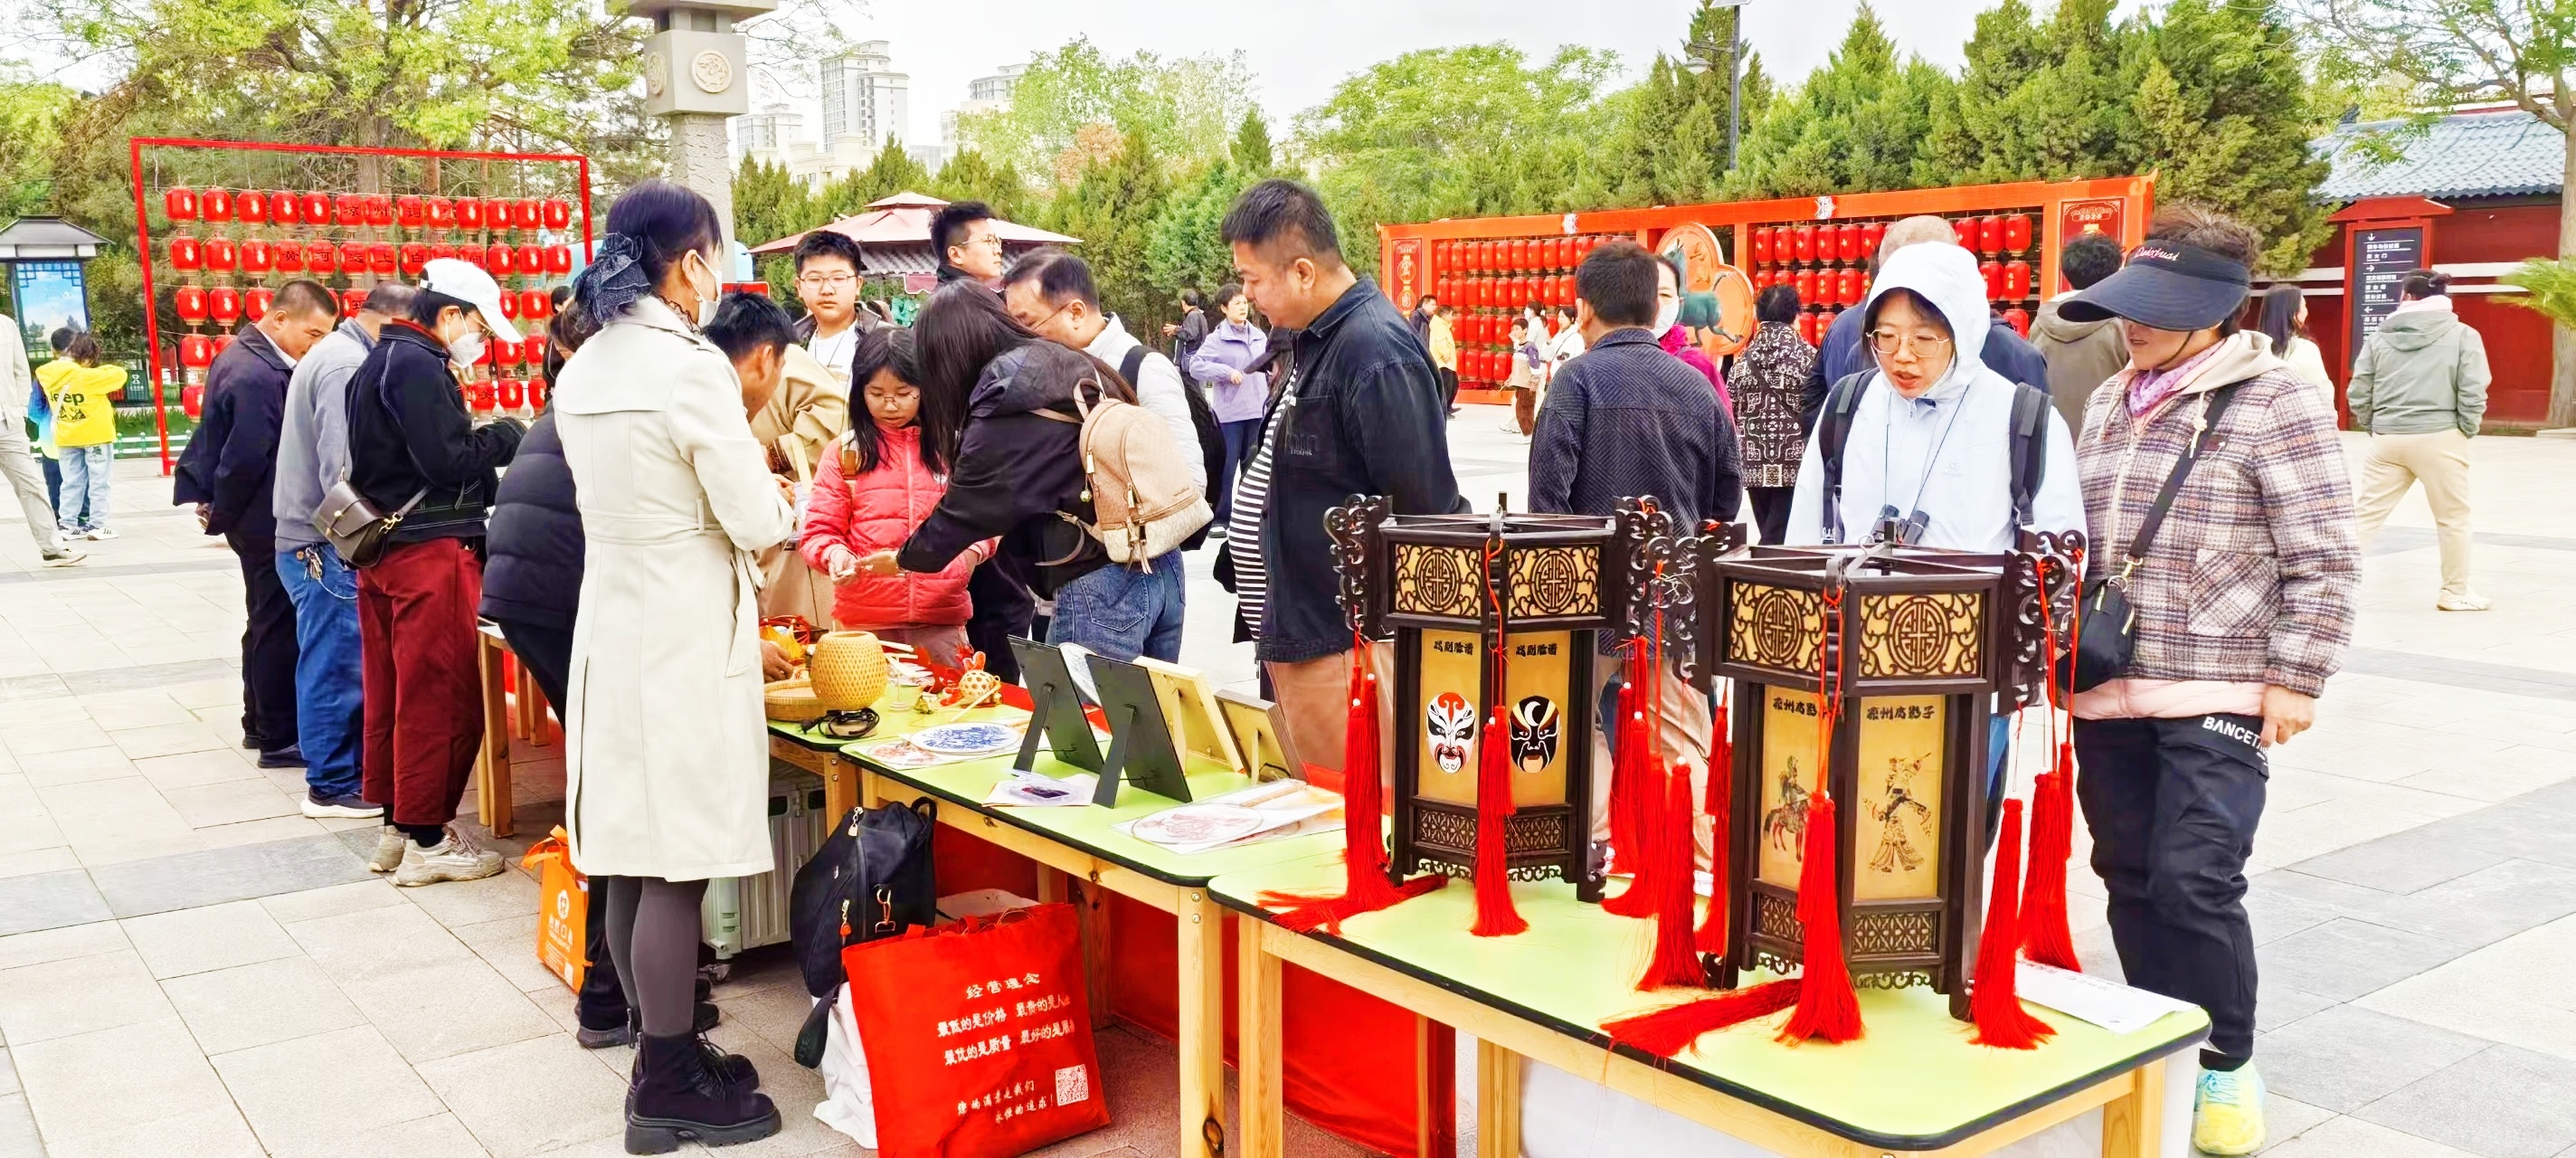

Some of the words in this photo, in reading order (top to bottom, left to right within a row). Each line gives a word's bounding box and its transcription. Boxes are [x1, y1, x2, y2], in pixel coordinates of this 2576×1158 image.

[280, 251, 483, 265] 黄河远上白间
[1772, 697, 1827, 719] 凉州皮影
[2202, 716, 2268, 755] BANCET
[965, 973, 1040, 1000] 经营理念
[937, 1006, 1008, 1039] 最低的是价格
[943, 1034, 1012, 1067] 最优的是质量
